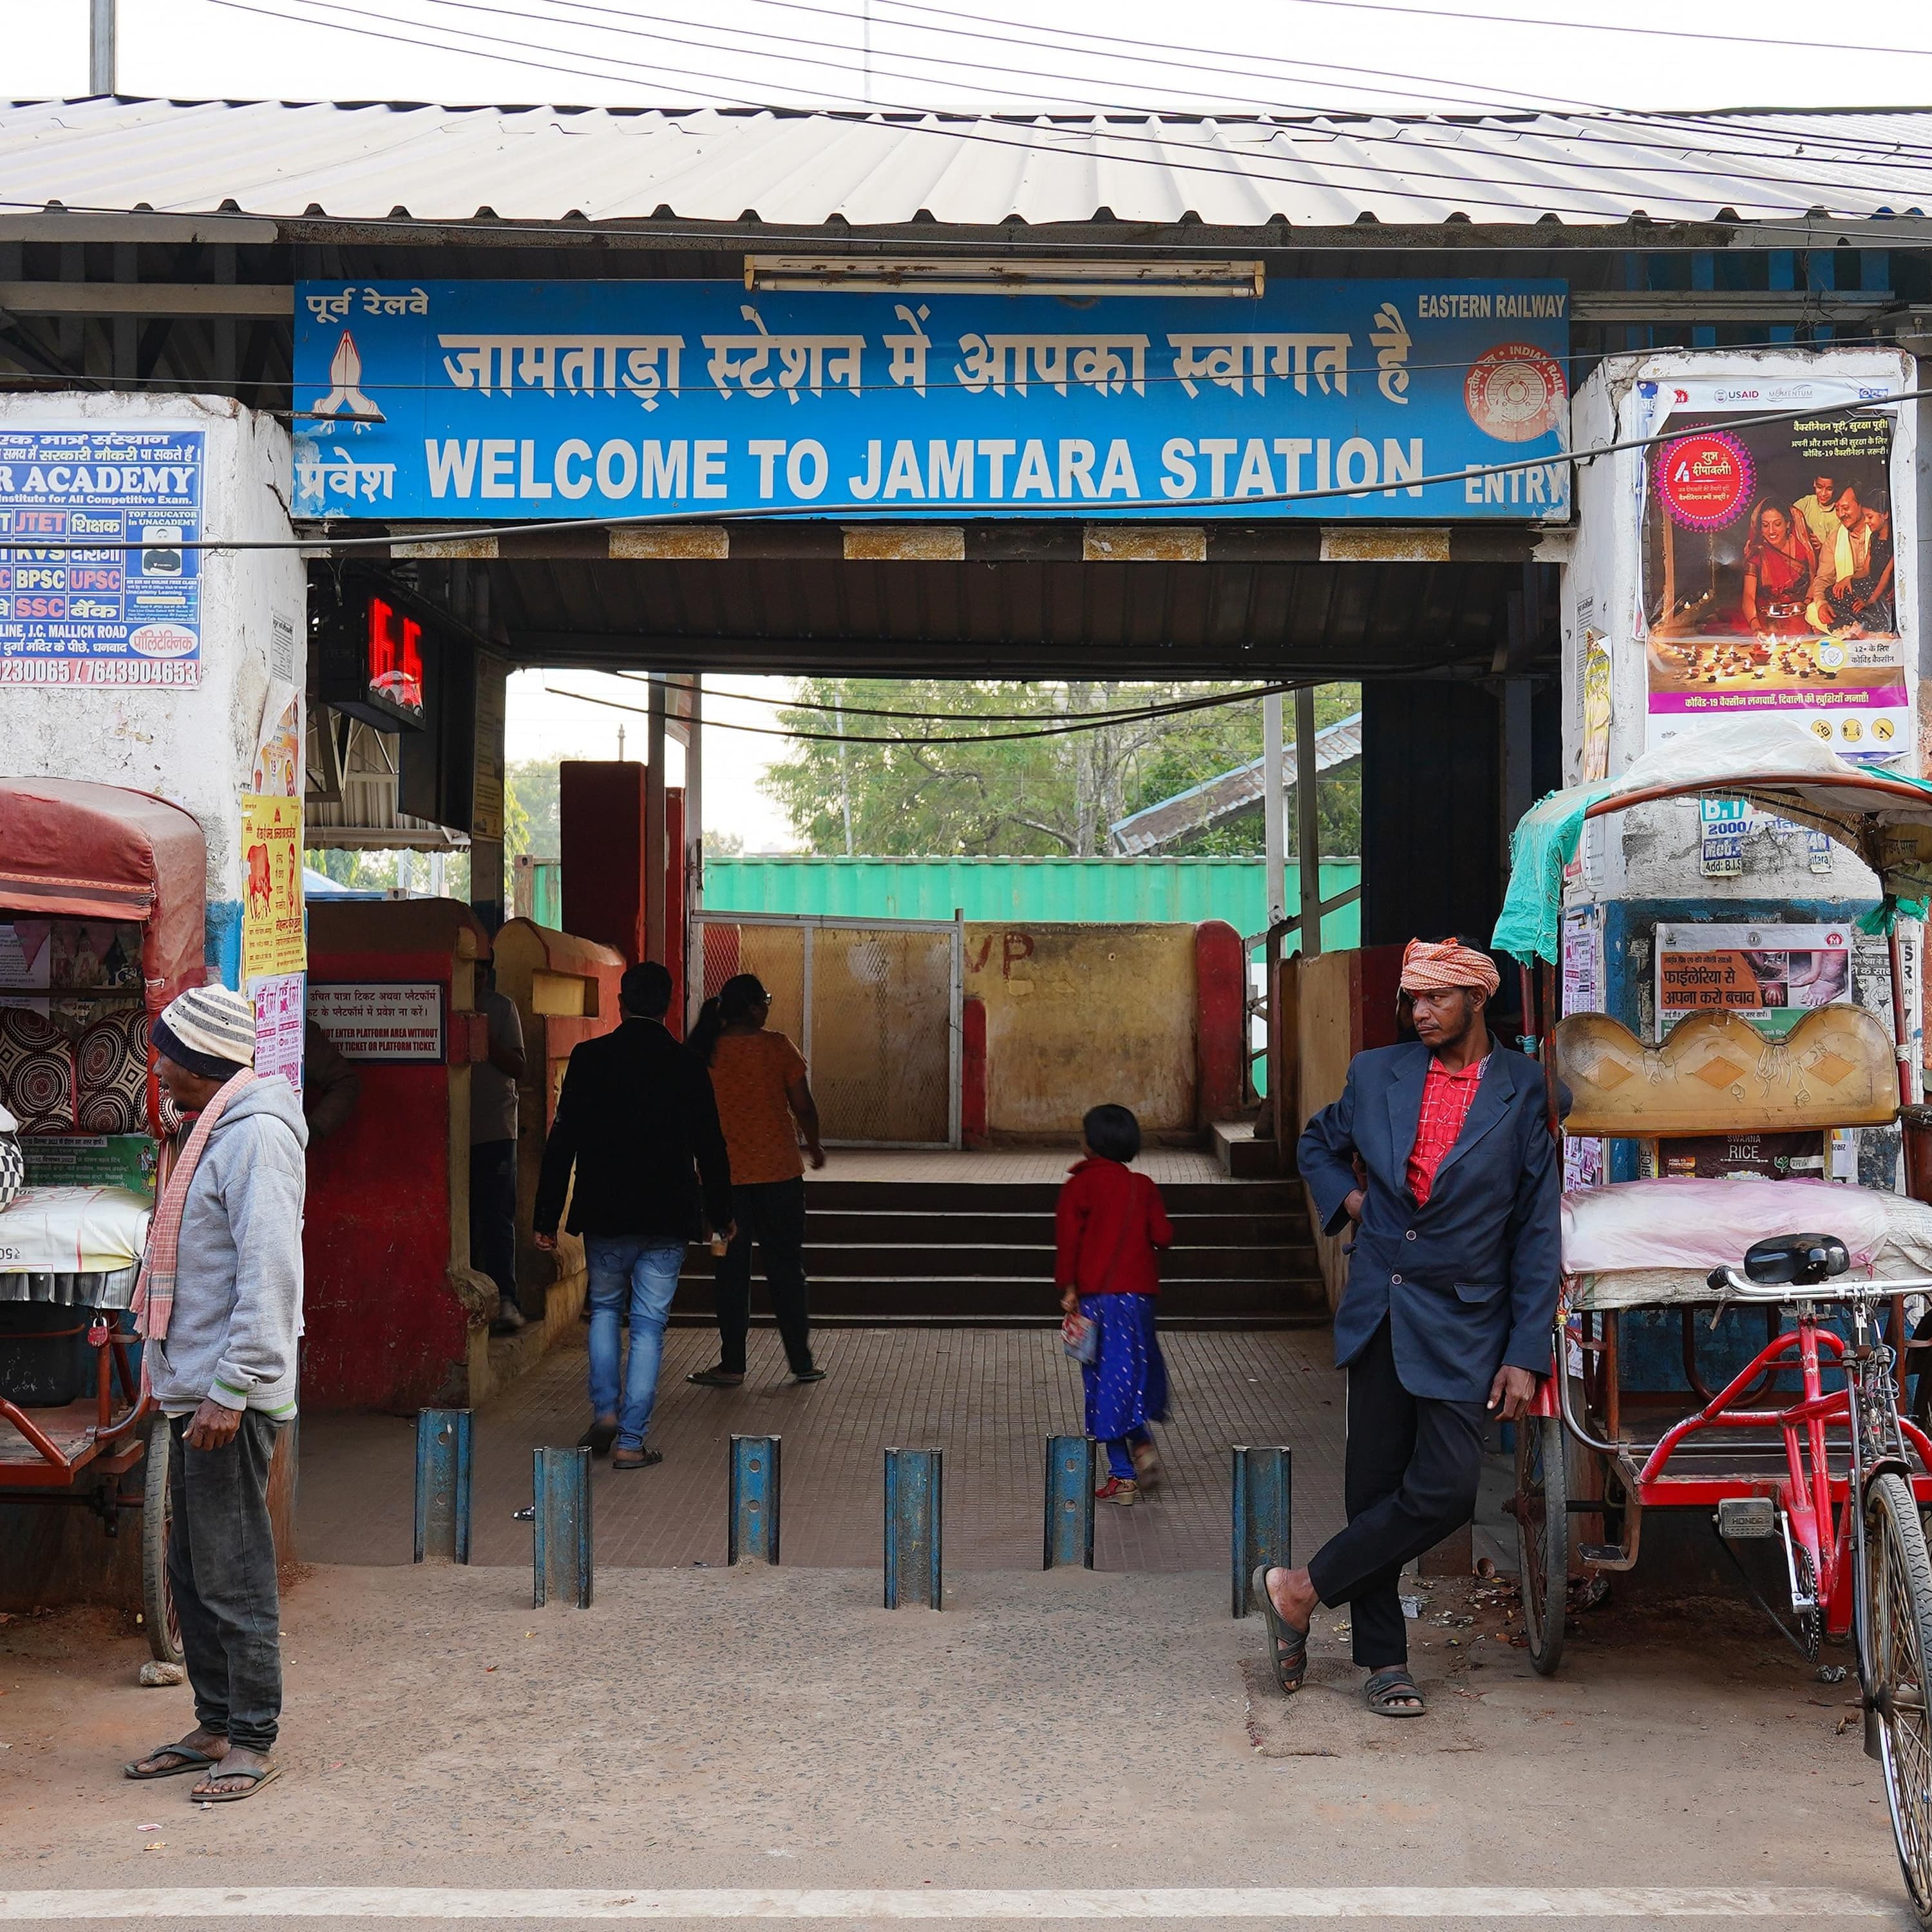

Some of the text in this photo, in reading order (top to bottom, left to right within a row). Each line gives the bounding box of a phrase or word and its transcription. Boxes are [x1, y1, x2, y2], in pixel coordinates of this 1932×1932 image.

[306, 288, 429, 323] पूर्व रेलवे
[1419, 294, 1566, 317] EASTERN RAILWAY
[438, 303, 1413, 412] जामताड़ा स्टेशन में आपका स्वागत है
[1794, 421, 1831, 431] वैक्सीनेशन
[1833, 420, 1848, 432] पूरी,
[1849, 421, 1871, 432] सुरक्षा
[1792, 439, 1808, 447] अपनी
[1810, 438, 1820, 447] और
[1868, 436, 1874, 444] के
[39, 446, 91, 460] सरकारी
[140, 449, 152, 460] पा
[1701, 451, 1718, 465] शुभ
[1803, 449, 1833, 457] कोविड-19
[296, 446, 397, 504] प्रवेश
[425, 437, 1423, 499] WELCOME TO JAMTARA STATION
[1691, 461, 1732, 476] दीपावली!
[21, 466, 195, 493] ACADEMY
[1465, 464, 1564, 504] ENTRY
[49, 495, 66, 504] for
[68, 495, 84, 504] All
[86, 495, 155, 506] Competitive
[158, 496, 192, 504] Exam.
[16, 512, 66, 532] JTET
[71, 513, 121, 533] शिक्षक
[16, 569, 65, 589] BPSC
[71, 571, 120, 589] UPSC
[15, 598, 64, 617] SSC
[49, 625, 95, 639] MALLICK
[97, 626, 128, 639] ROAD
[54, 639, 66, 652] के
[1877, 644, 1889, 652] लिए
[1852, 655, 1870, 663] कोविड
[86, 660, 197, 684] 7643904653
[1685, 698, 1718, 707] कोविड-19
[1719, 696, 1746, 706] वैक्सीन
[1779, 694, 1803, 705] दिवाली
[1805, 693, 1814, 704] की
[1663, 966, 1736, 986] फाईलेरिया से
[309, 989, 436, 1001] उचित यात्रा टिकट अथवा प्लेटफॉर्म
[1664, 987, 1756, 1005] अपना करो बचाव
[321, 1006, 329, 1016] के
[332, 1005, 363, 1016] प्लेटफॉर्म
[376, 1006, 395, 1016] प्रवेश
[399, 1008, 407, 1016] ना
[335, 1028, 438, 1038] ENTER PLATFORM AREA WITHOUT
[345, 1042, 437, 1052] TICKET OR PLATFORM TICKET.
[1729, 1145, 1759, 1159] RICE
